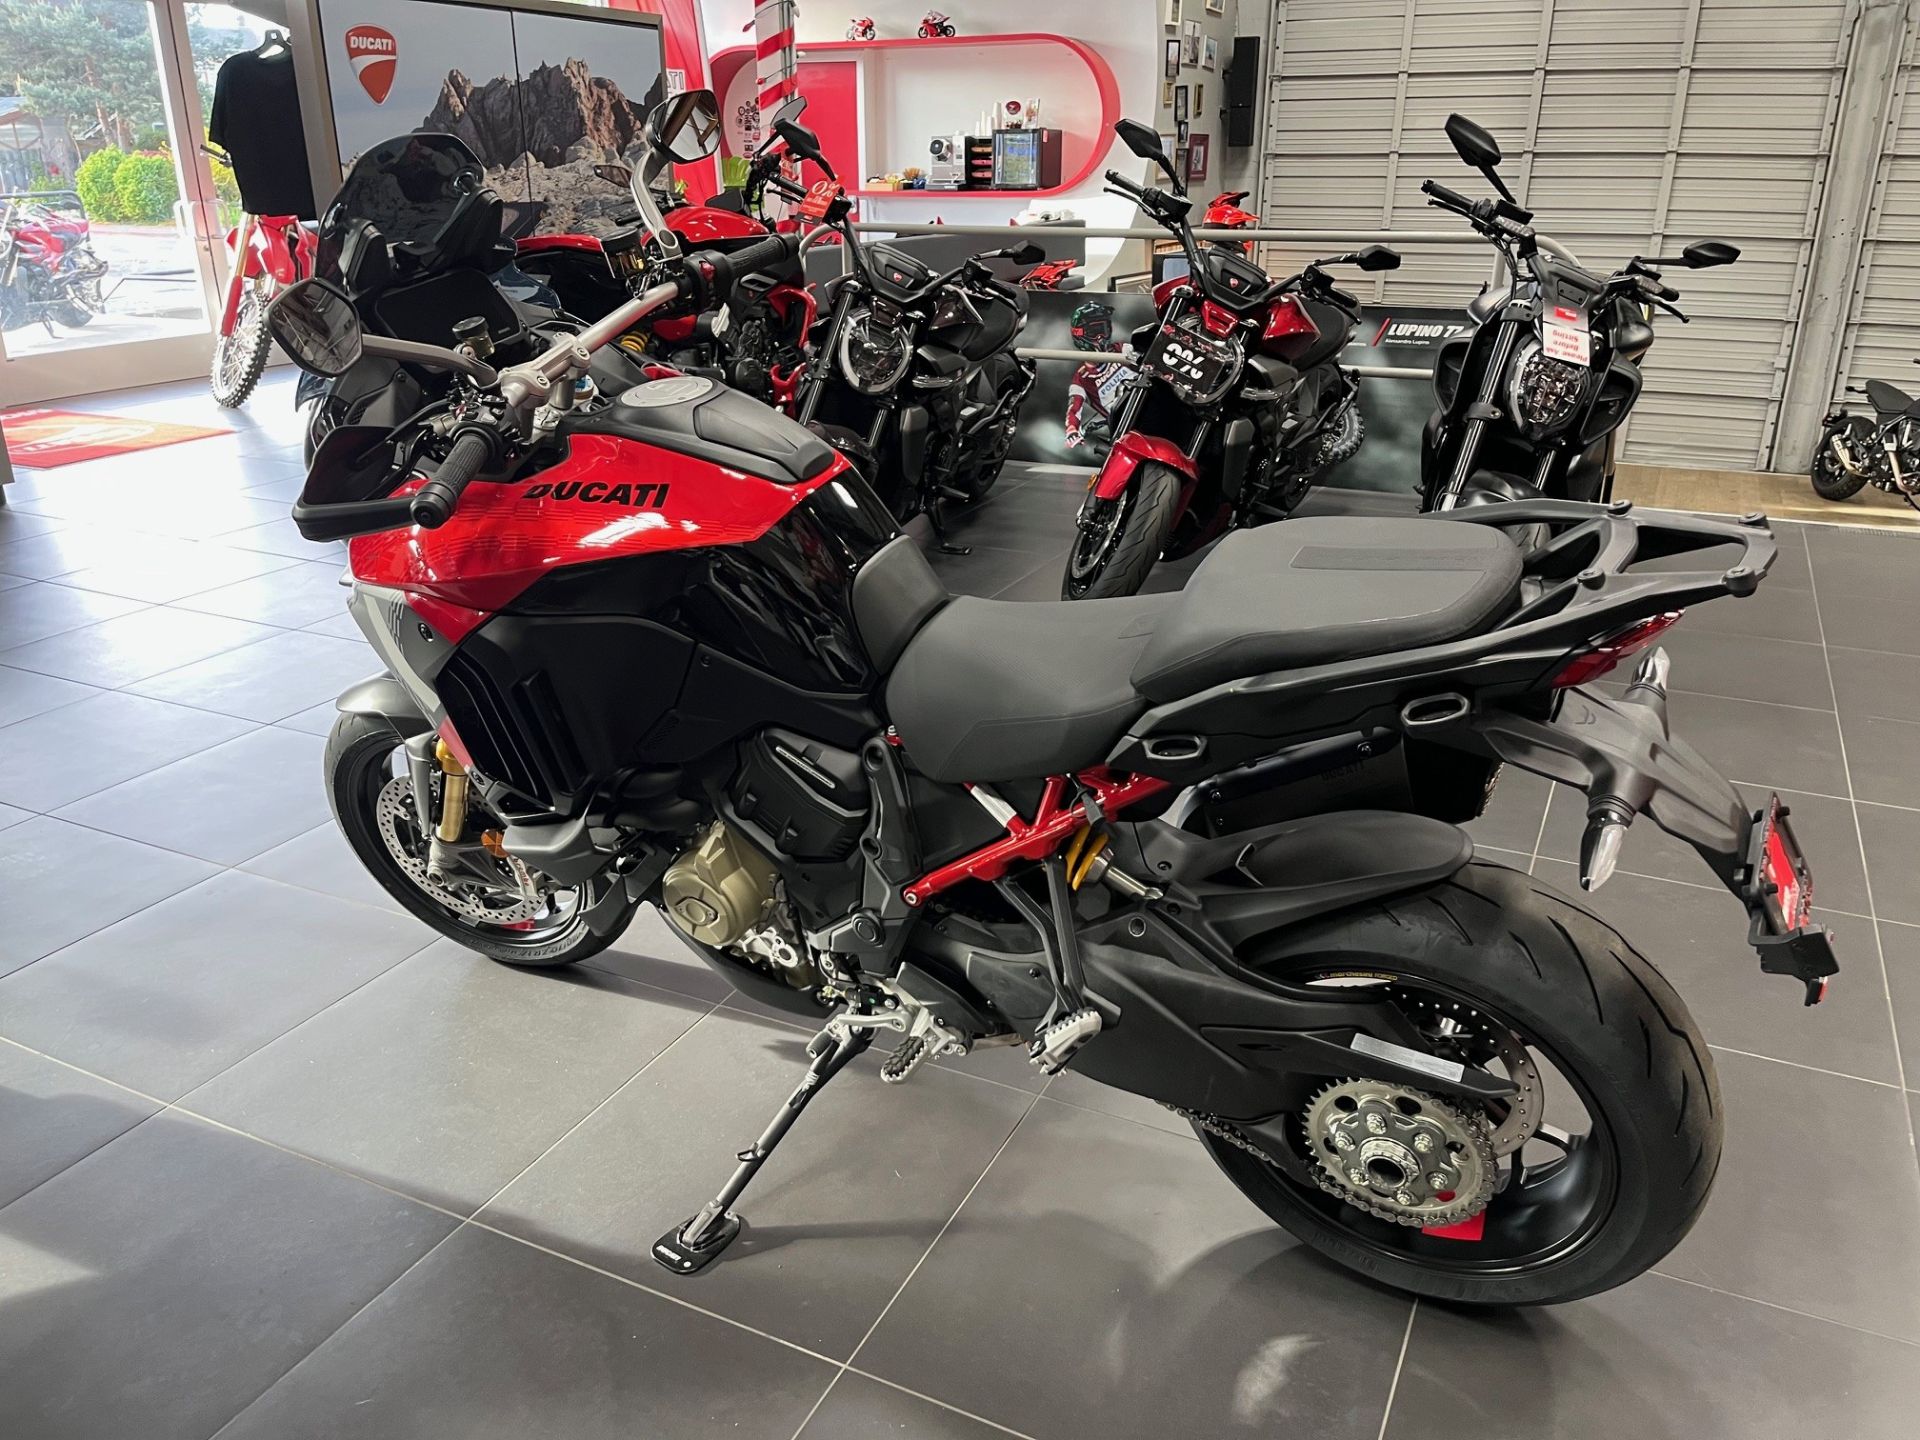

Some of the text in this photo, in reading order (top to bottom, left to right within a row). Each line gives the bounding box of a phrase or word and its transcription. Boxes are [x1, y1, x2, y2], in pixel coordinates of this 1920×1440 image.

[350, 35, 392, 51] DUCATI
[1388, 324, 1443, 338] LUPINO
[1100, 369, 1128, 396] POLIZIA
[522, 480, 670, 508] DUCATI
